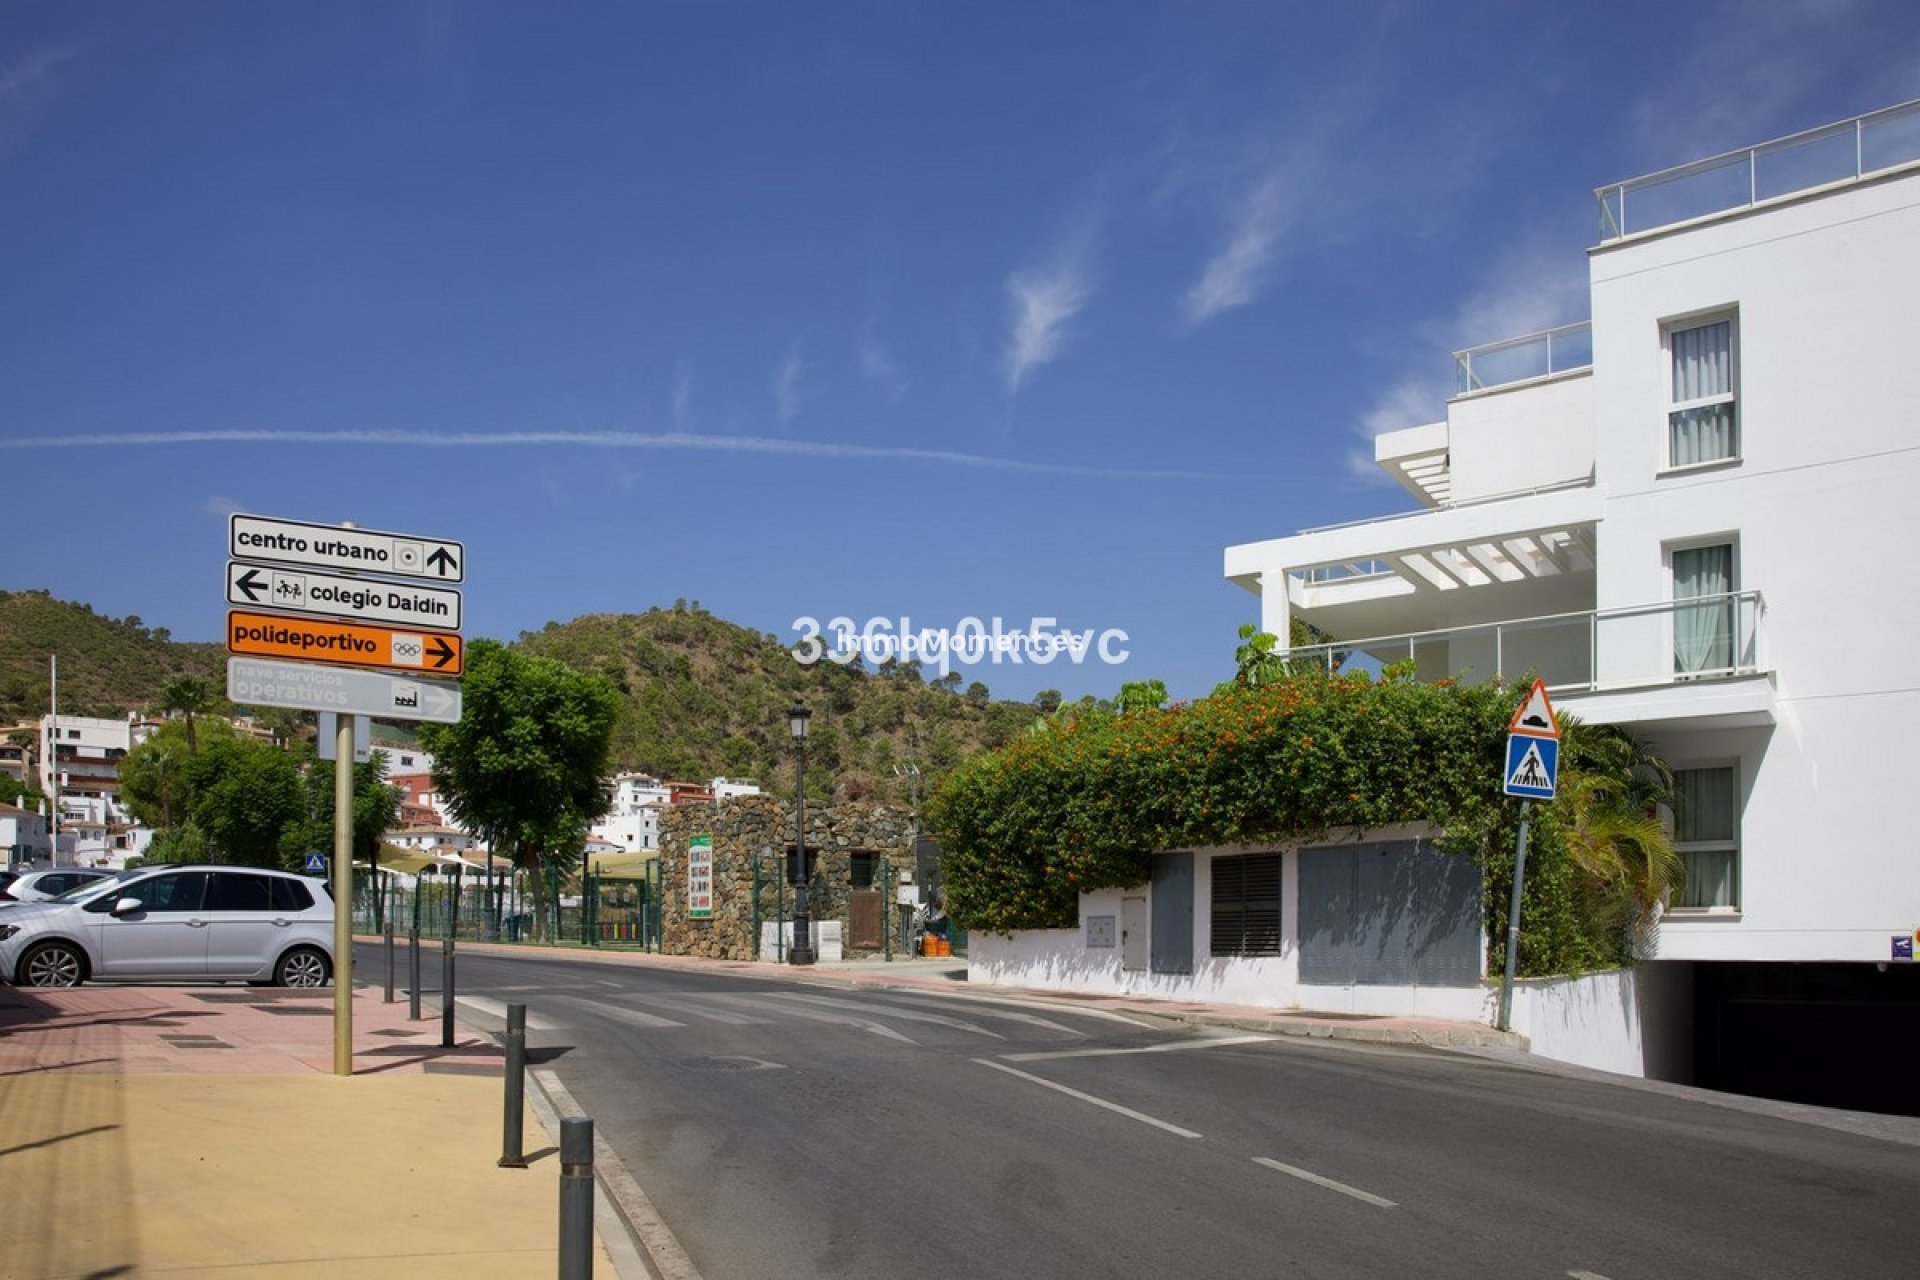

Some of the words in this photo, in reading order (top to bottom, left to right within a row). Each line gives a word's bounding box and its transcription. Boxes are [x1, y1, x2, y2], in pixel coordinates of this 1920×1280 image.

[238, 531, 307, 552] centro
[314, 540, 388, 561] urbano
[310, 586, 382, 609] colegio
[234, 624, 377, 653] polideportivo
[277, 669, 343, 686] servicios
[237, 680, 349, 705] operativos
